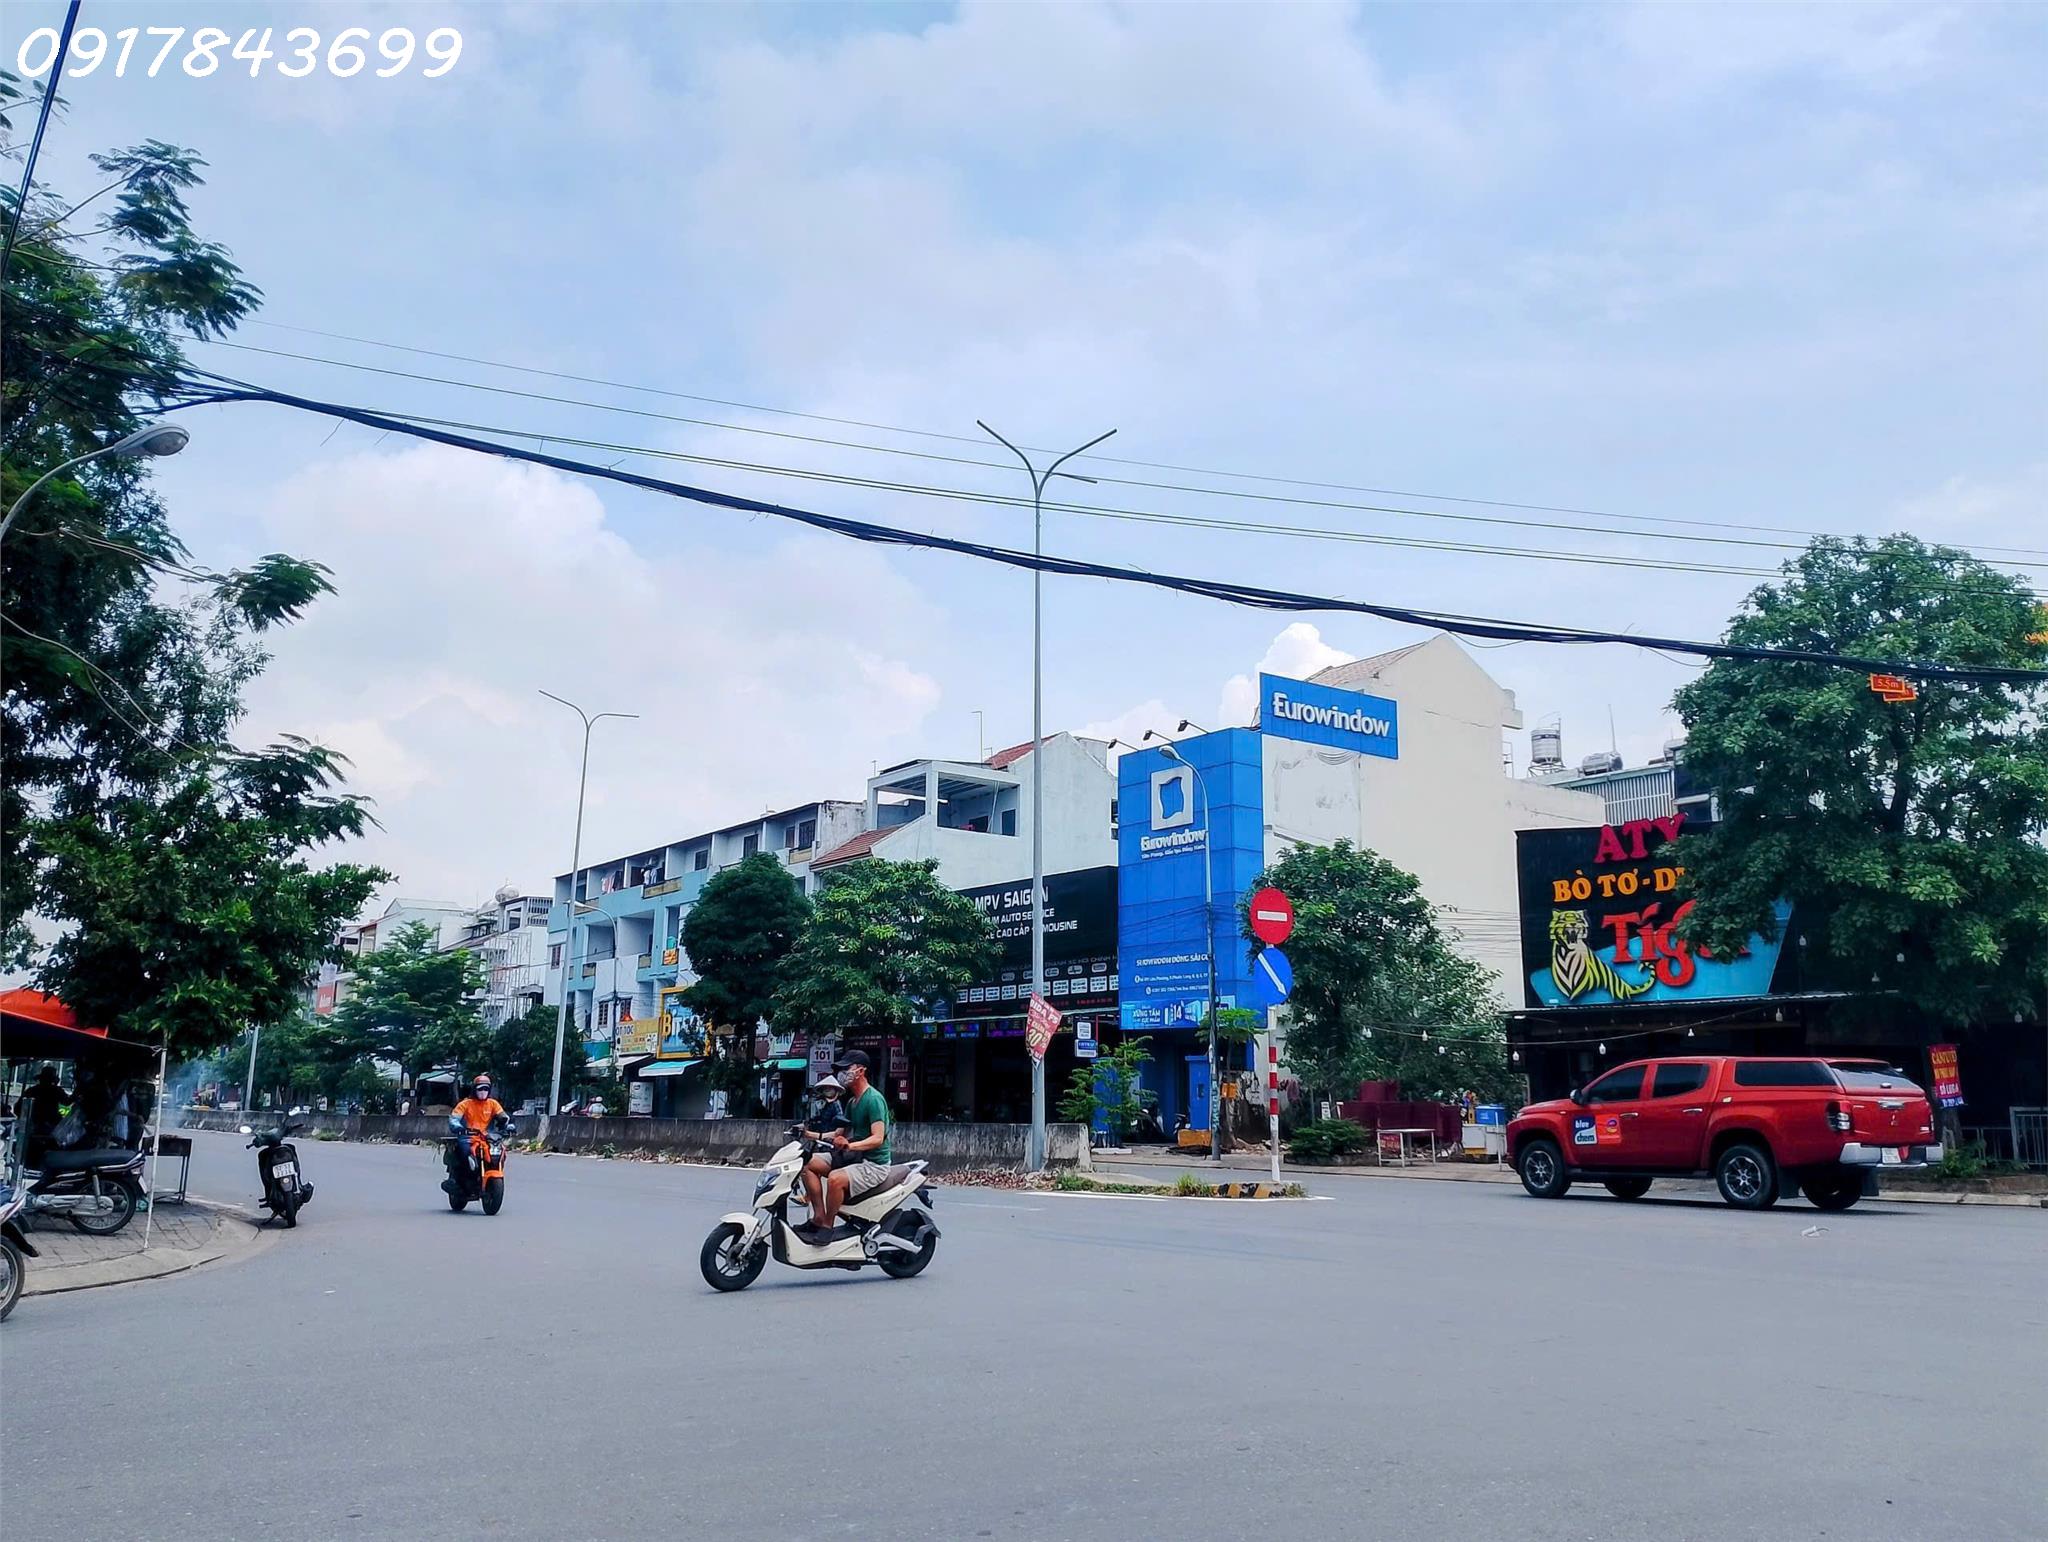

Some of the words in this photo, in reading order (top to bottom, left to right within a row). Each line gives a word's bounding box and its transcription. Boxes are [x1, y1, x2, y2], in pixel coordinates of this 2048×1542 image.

[1272, 691, 1390, 737] Eurowindow
[1140, 829, 1206, 852] Eurowindow
[1552, 870, 1592, 903] BÒ
[1597, 868, 1640, 898] TƠ
[815, 1050, 831, 1061] 101
